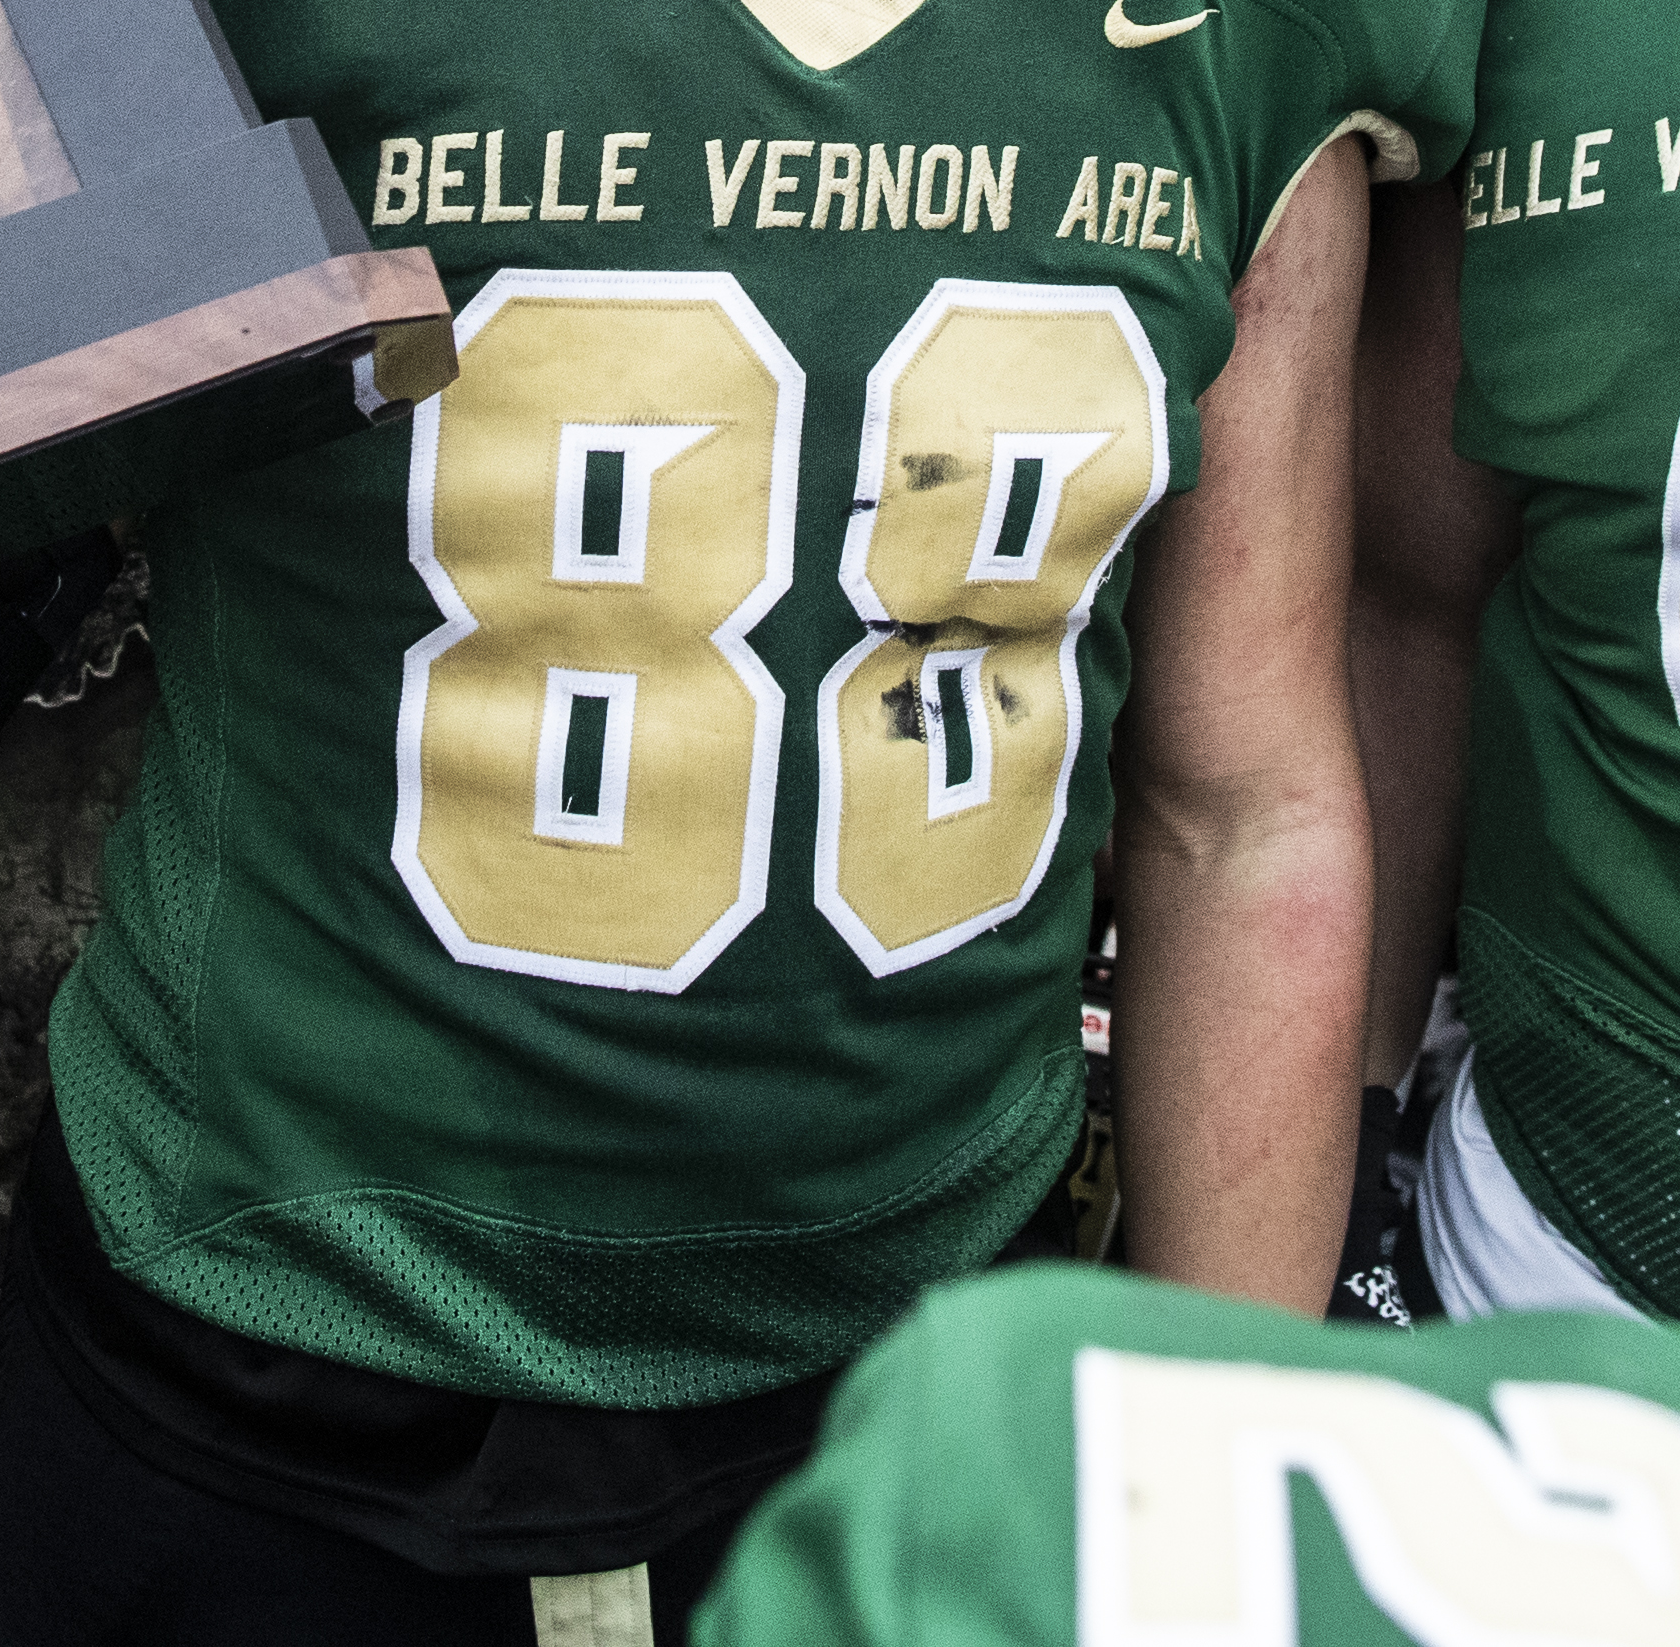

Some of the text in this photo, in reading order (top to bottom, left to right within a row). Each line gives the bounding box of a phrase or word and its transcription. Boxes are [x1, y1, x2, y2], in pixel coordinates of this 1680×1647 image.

[372, 131, 1203, 263] BELLE VERNON AREA
[389, 267, 1169, 996] 88
